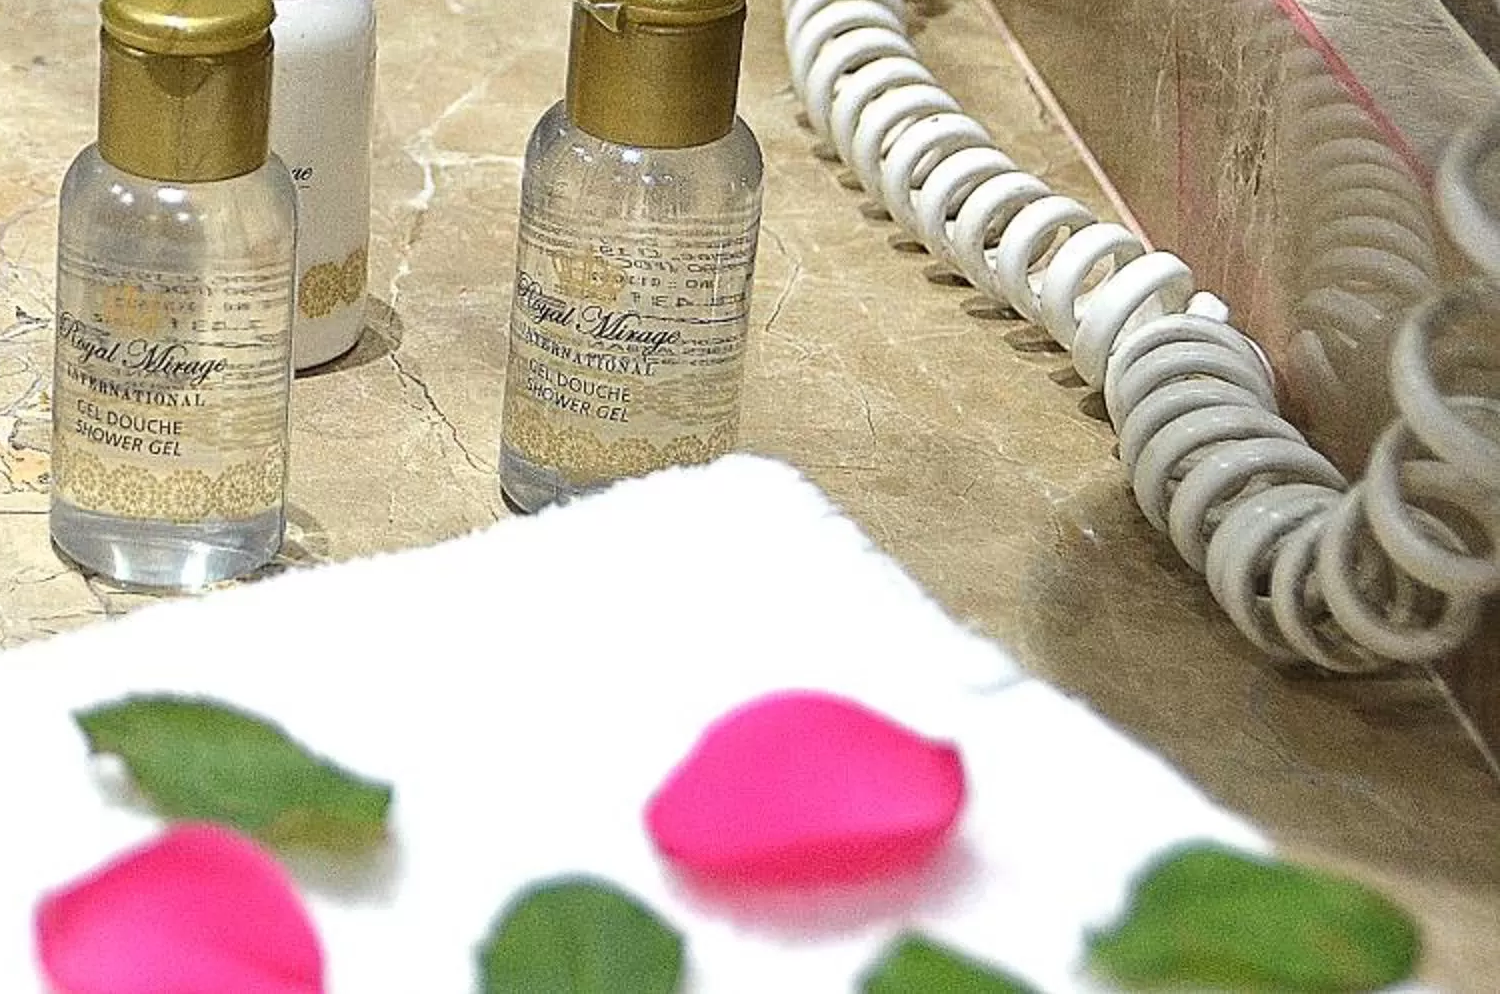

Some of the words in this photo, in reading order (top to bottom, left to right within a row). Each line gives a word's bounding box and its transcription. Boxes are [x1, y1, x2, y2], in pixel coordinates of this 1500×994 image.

[517, 271, 575, 326] Royal
[576, 306, 680, 356] Mirage
[60, 311, 121, 364] Royal
[122, 338, 227, 384] Mirage
[519, 321, 657, 377] INTERNATIONAL
[67, 364, 205, 407] INTERNATIONAL
[527, 377, 591, 416] SHOWER
[596, 405, 629, 423] GEL
[529, 359, 552, 380] GEL
[557, 375, 631, 403] DOUCHE
[75, 420, 144, 453] SHOWER
[148, 440, 182, 457] GEL
[77, 399, 101, 420] GEL
[107, 410, 183, 435] DOUCHE
